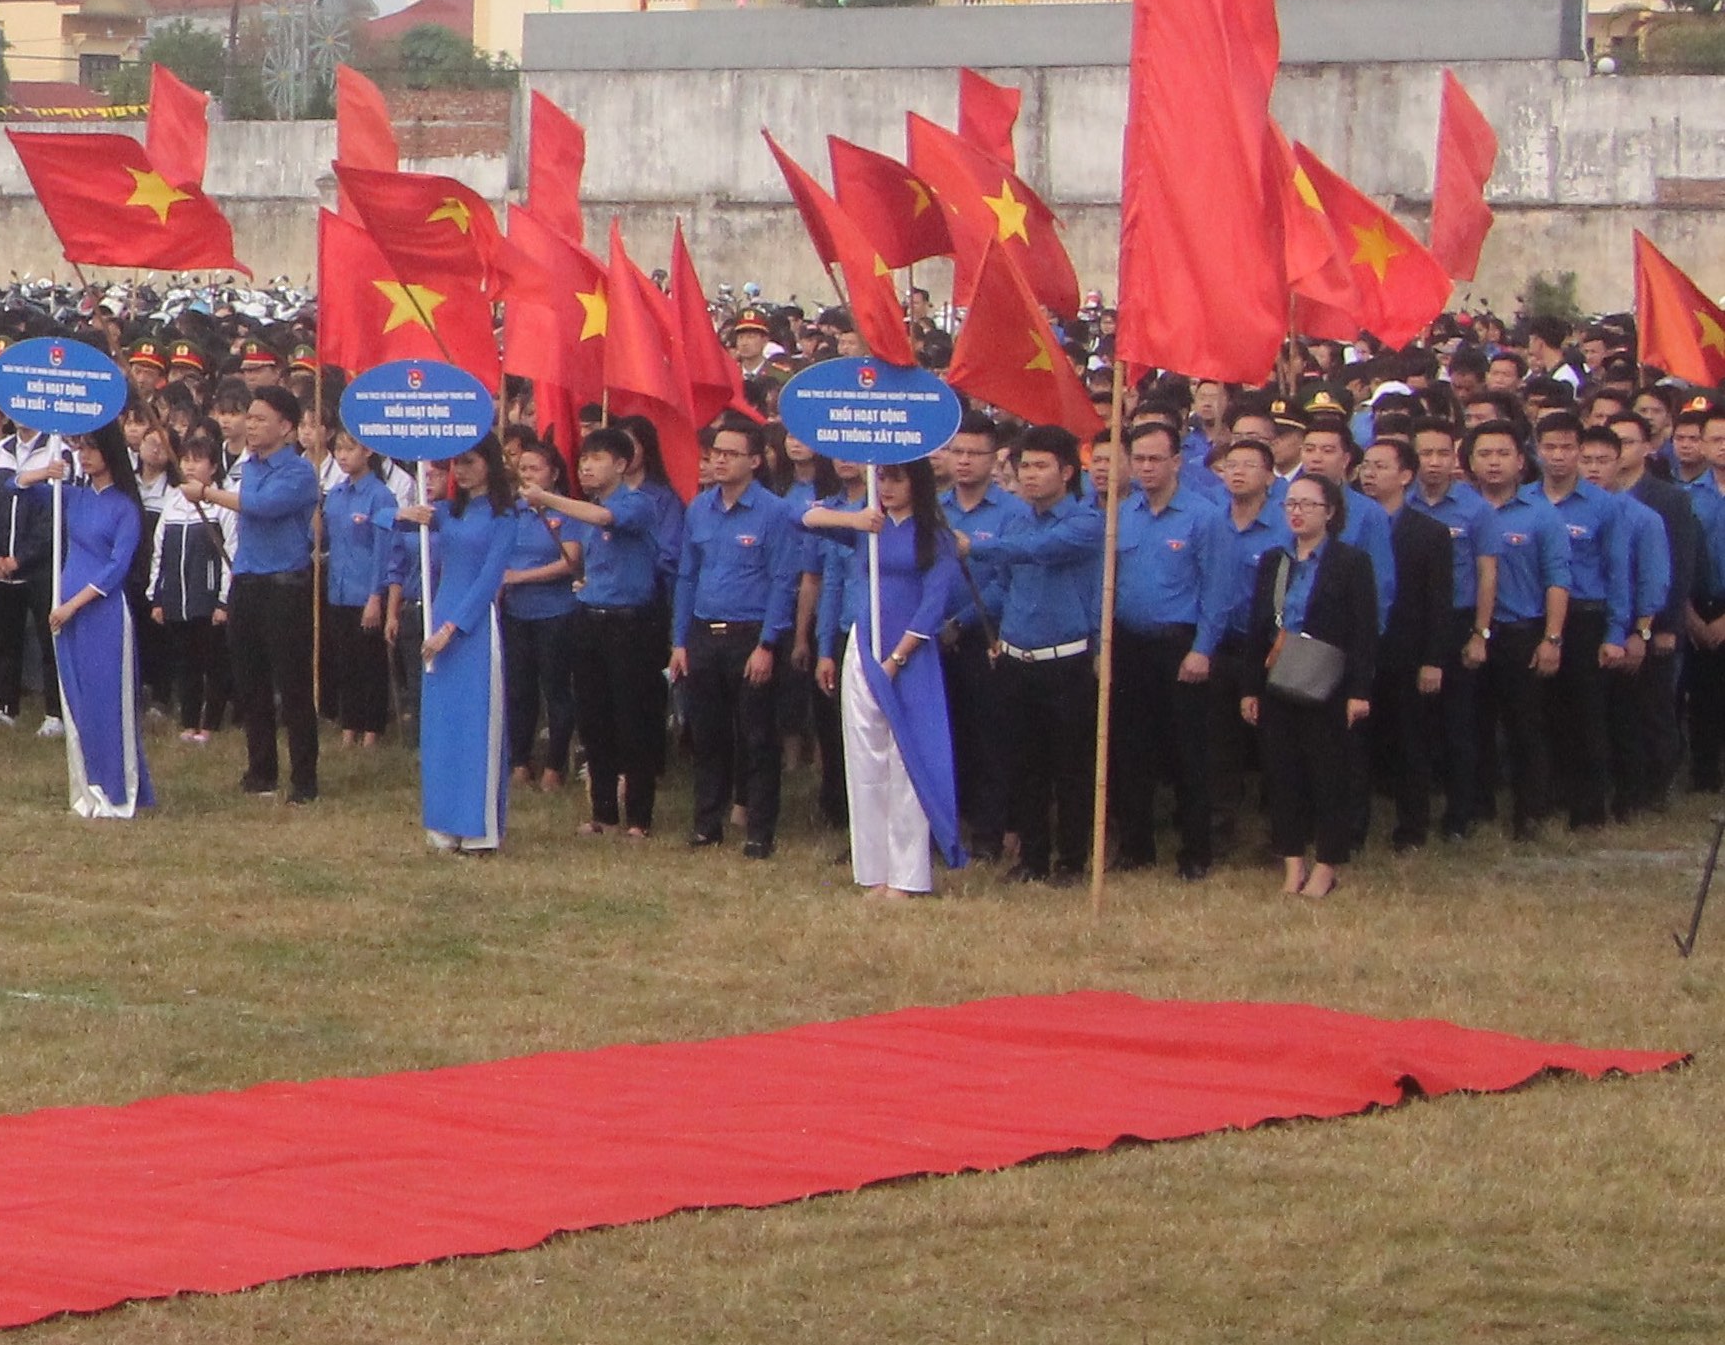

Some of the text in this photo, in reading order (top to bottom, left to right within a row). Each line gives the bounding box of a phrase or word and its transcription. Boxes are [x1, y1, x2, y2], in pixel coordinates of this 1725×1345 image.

[830, 406, 908, 424] KHỐI HOẠT ĐỘNG
[817, 427, 922, 446] GIAO THÔNG XÂY DỰNG
